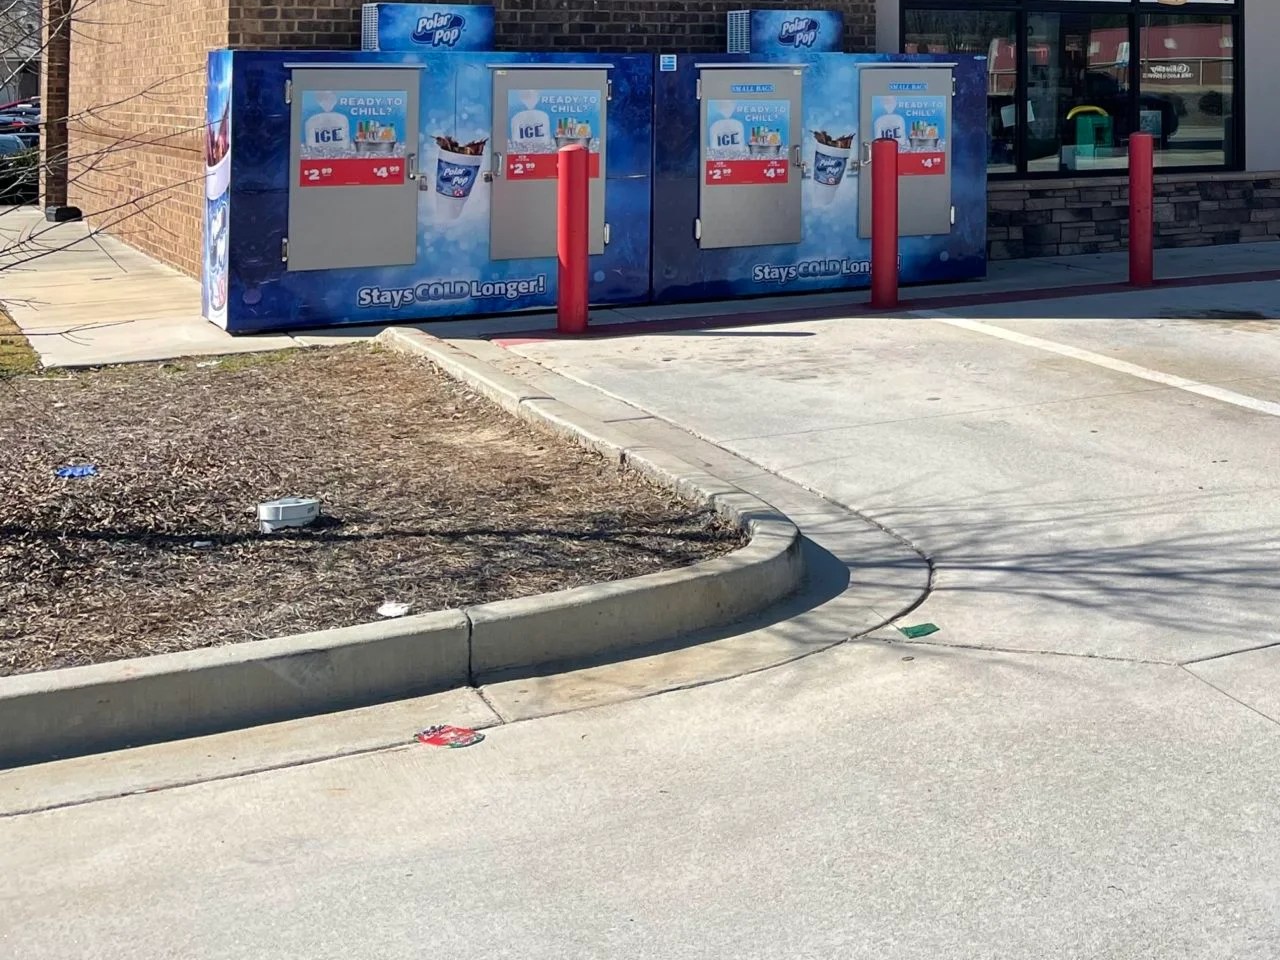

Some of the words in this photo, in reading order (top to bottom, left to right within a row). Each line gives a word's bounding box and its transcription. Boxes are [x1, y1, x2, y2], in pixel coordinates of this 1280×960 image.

[417, 13, 451, 33] Polar
[782, 18, 809, 36] Polar
[433, 28, 459, 44] Pop
[795, 31, 815, 46] Pop
[340, 97, 382, 106] READY
[387, 97, 402, 106] TO
[541, 95, 578, 104] READY
[583, 95, 597, 104] TO
[898, 101, 928, 109] READY
[932, 101, 944, 109] TO
[350, 107, 392, 116] CHILL?
[550, 105, 588, 113] CHILL?
[736, 105, 769, 113] READY
[744, 114, 778, 122] CHILL?
[314, 127, 343, 143] ICE
[519, 123, 545, 139] ICE
[881, 126, 901, 139] ICE
[717, 132, 740, 146] ICE
[443, 167, 466, 176] Polar
[452, 176, 469, 186] Pop
[754, 265, 796, 282] Stays
[799, 259, 841, 277] COLD
[842, 255, 901, 274] Lon!
[359, 289, 414, 307] Stays
[416, 280, 469, 301] COLD
[470, 275, 545, 298] Longer!
